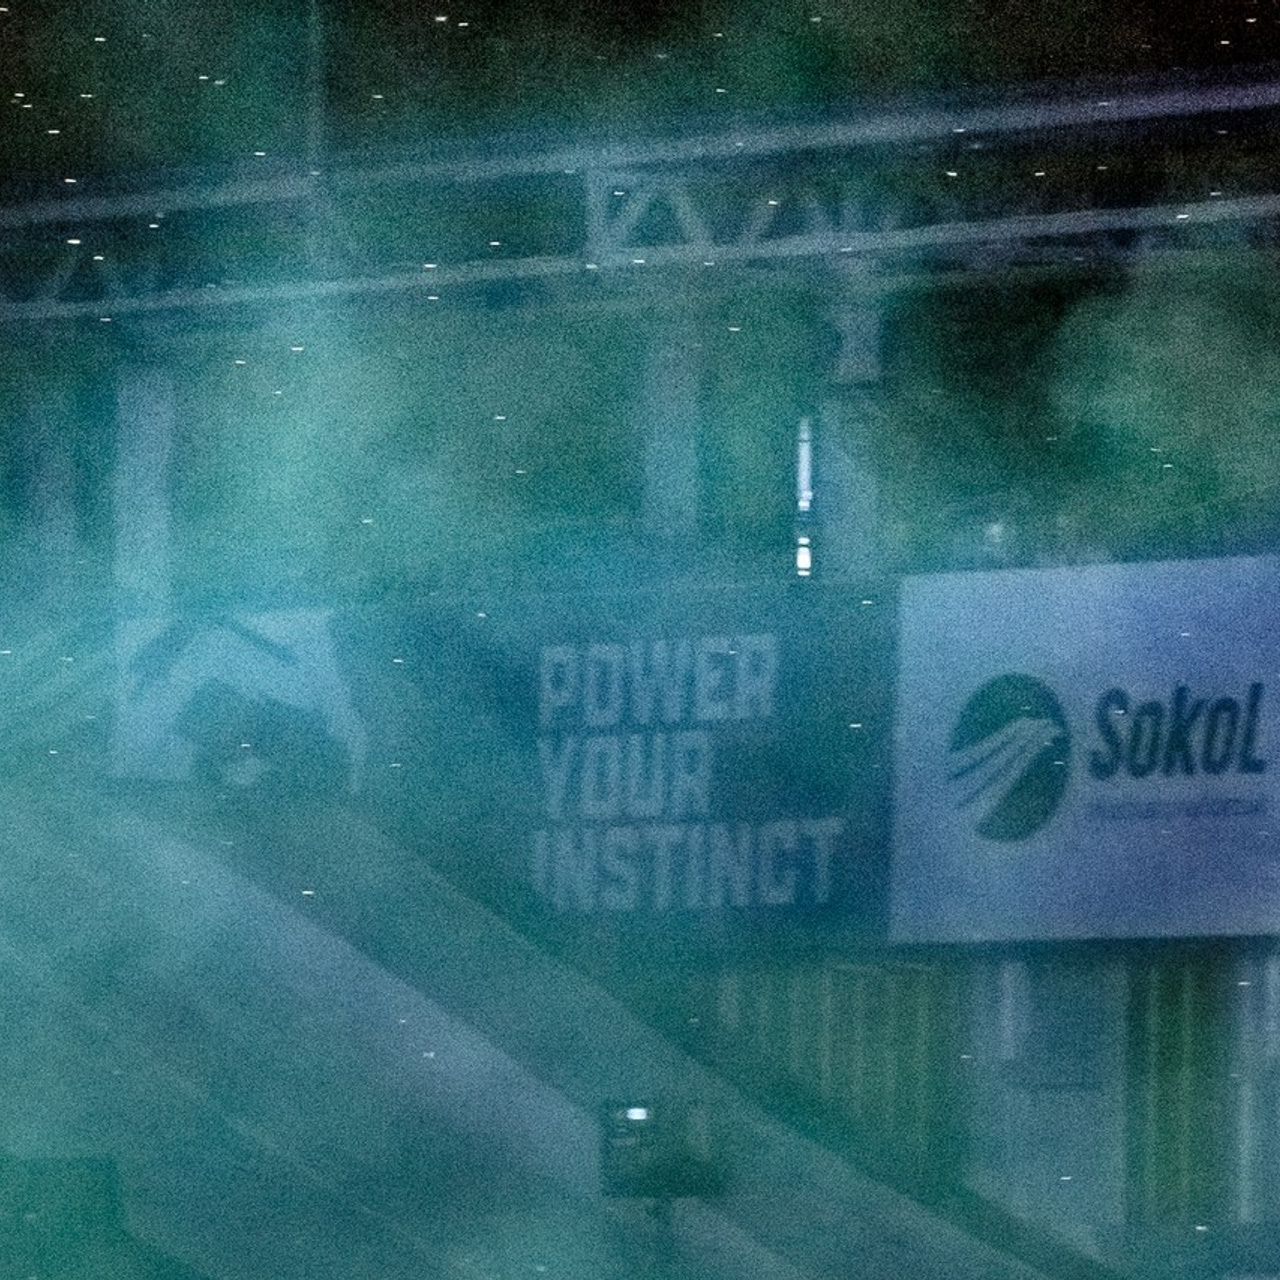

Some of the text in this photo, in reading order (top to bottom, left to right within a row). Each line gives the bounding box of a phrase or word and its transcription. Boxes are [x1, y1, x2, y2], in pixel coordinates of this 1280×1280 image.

[540, 632, 777, 728] POWER
[537, 729, 712, 820] YOUR
[532, 816, 845, 912] INSTINCT
